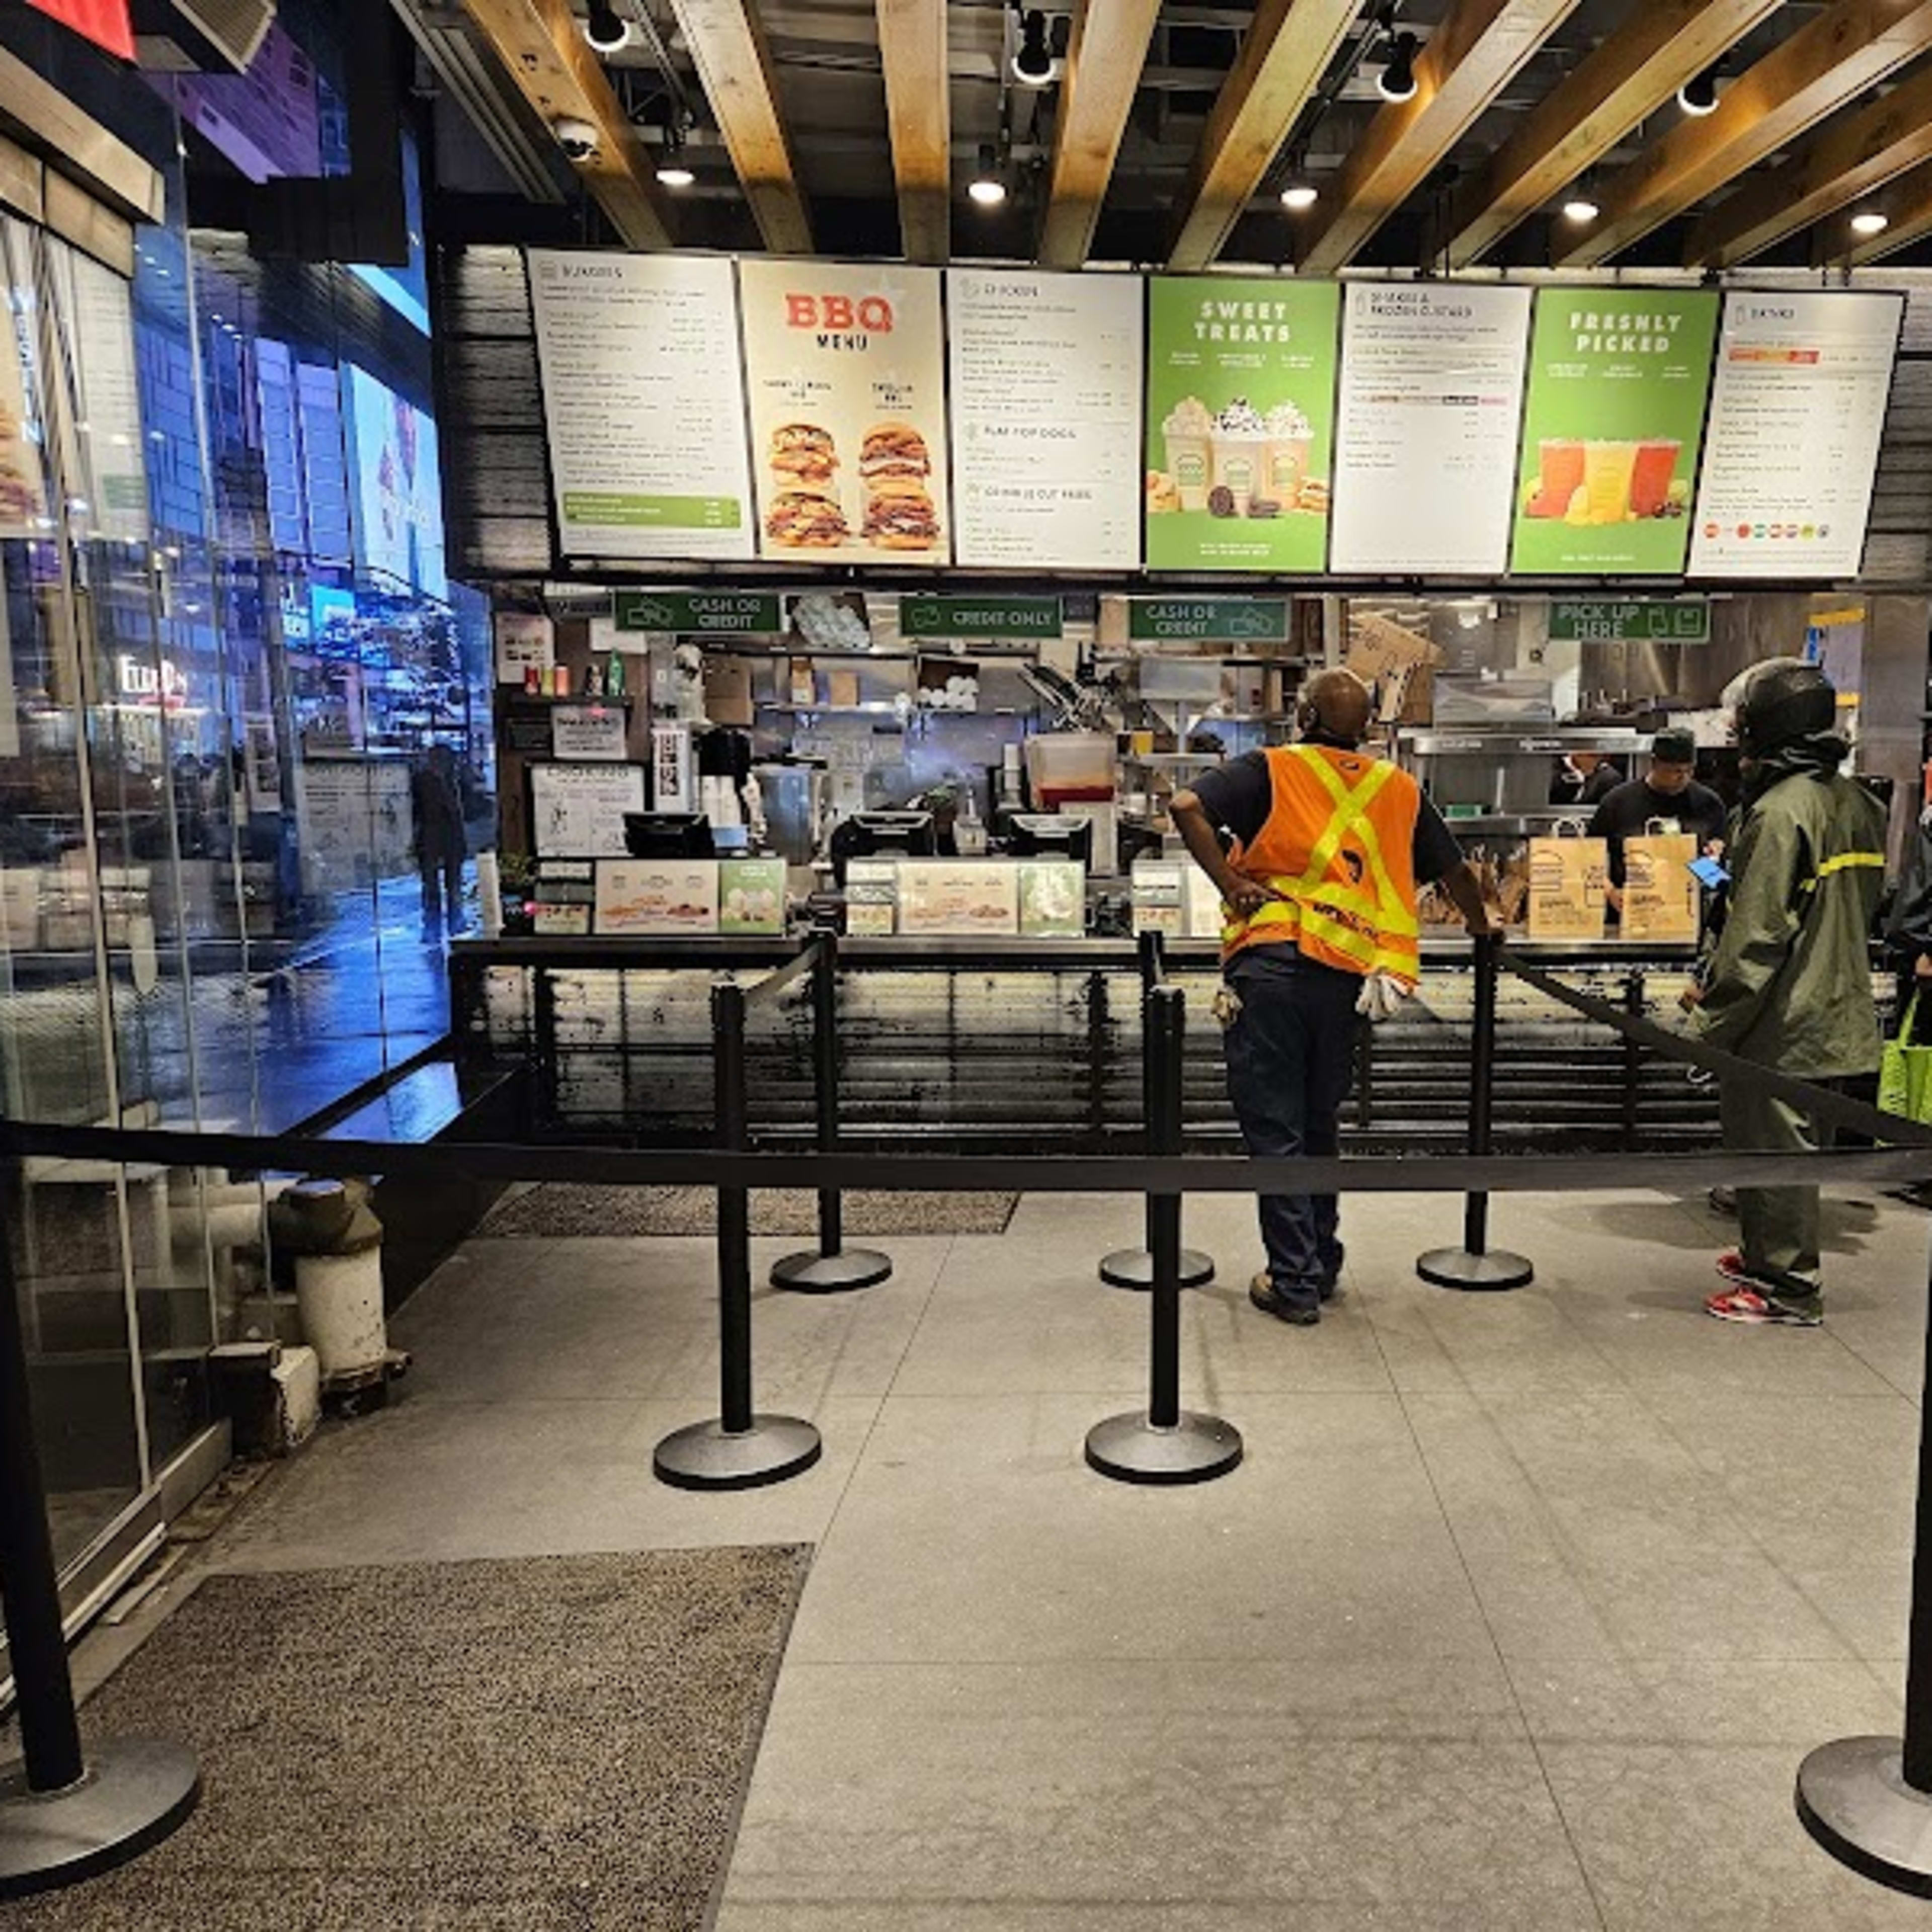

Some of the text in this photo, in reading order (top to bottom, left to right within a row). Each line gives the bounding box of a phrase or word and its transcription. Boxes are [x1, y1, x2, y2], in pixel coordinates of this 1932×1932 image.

[786, 295, 893, 333] BBQ
[1201, 301, 1286, 319] SWEET
[1570, 312, 1682, 332] FRESHLY
[1194, 322, 1290, 342] TREATS
[817, 335, 866, 351] MENU
[1577, 335, 1669, 352] PICKED
[688, 599, 761, 612] CASH OR
[1146, 605, 1217, 618] CASH OR
[1558, 605, 1639, 620] PICK UP
[698, 615, 754, 628] CREDIT
[953, 611, 1053, 625] CREDIT ONLY
[1156, 621, 1208, 634] CREDIT
[1574, 621, 1624, 638] HERE
